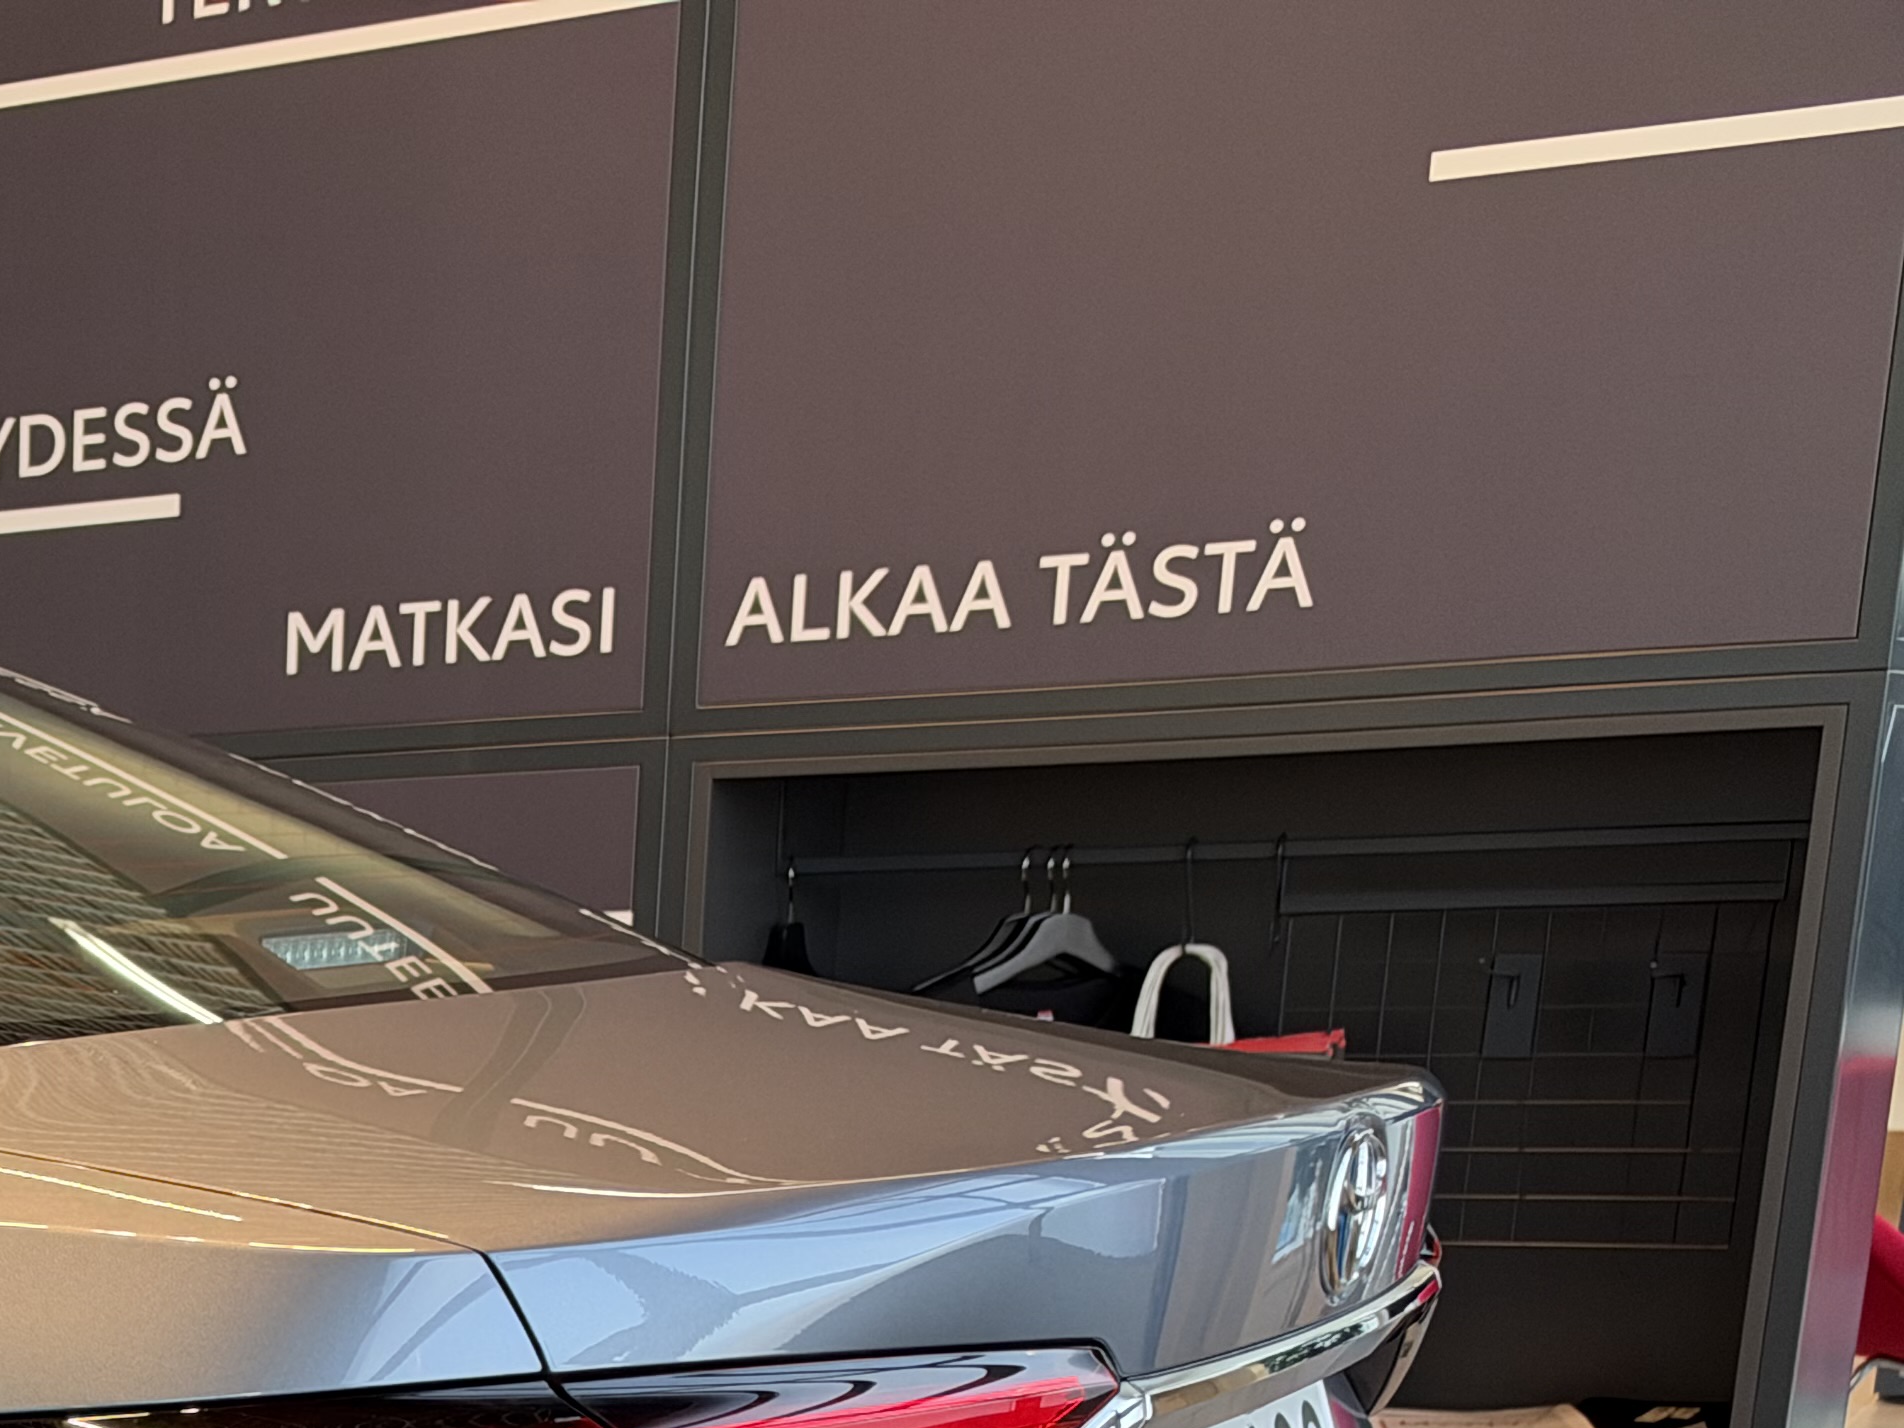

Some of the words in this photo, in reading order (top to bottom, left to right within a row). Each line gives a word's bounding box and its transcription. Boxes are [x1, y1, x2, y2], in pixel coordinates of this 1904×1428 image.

[285, 586, 616, 677] MATKASI
[725, 559, 1013, 647] ALKAA
[1038, 516, 1314, 628] TÄSTÄ
